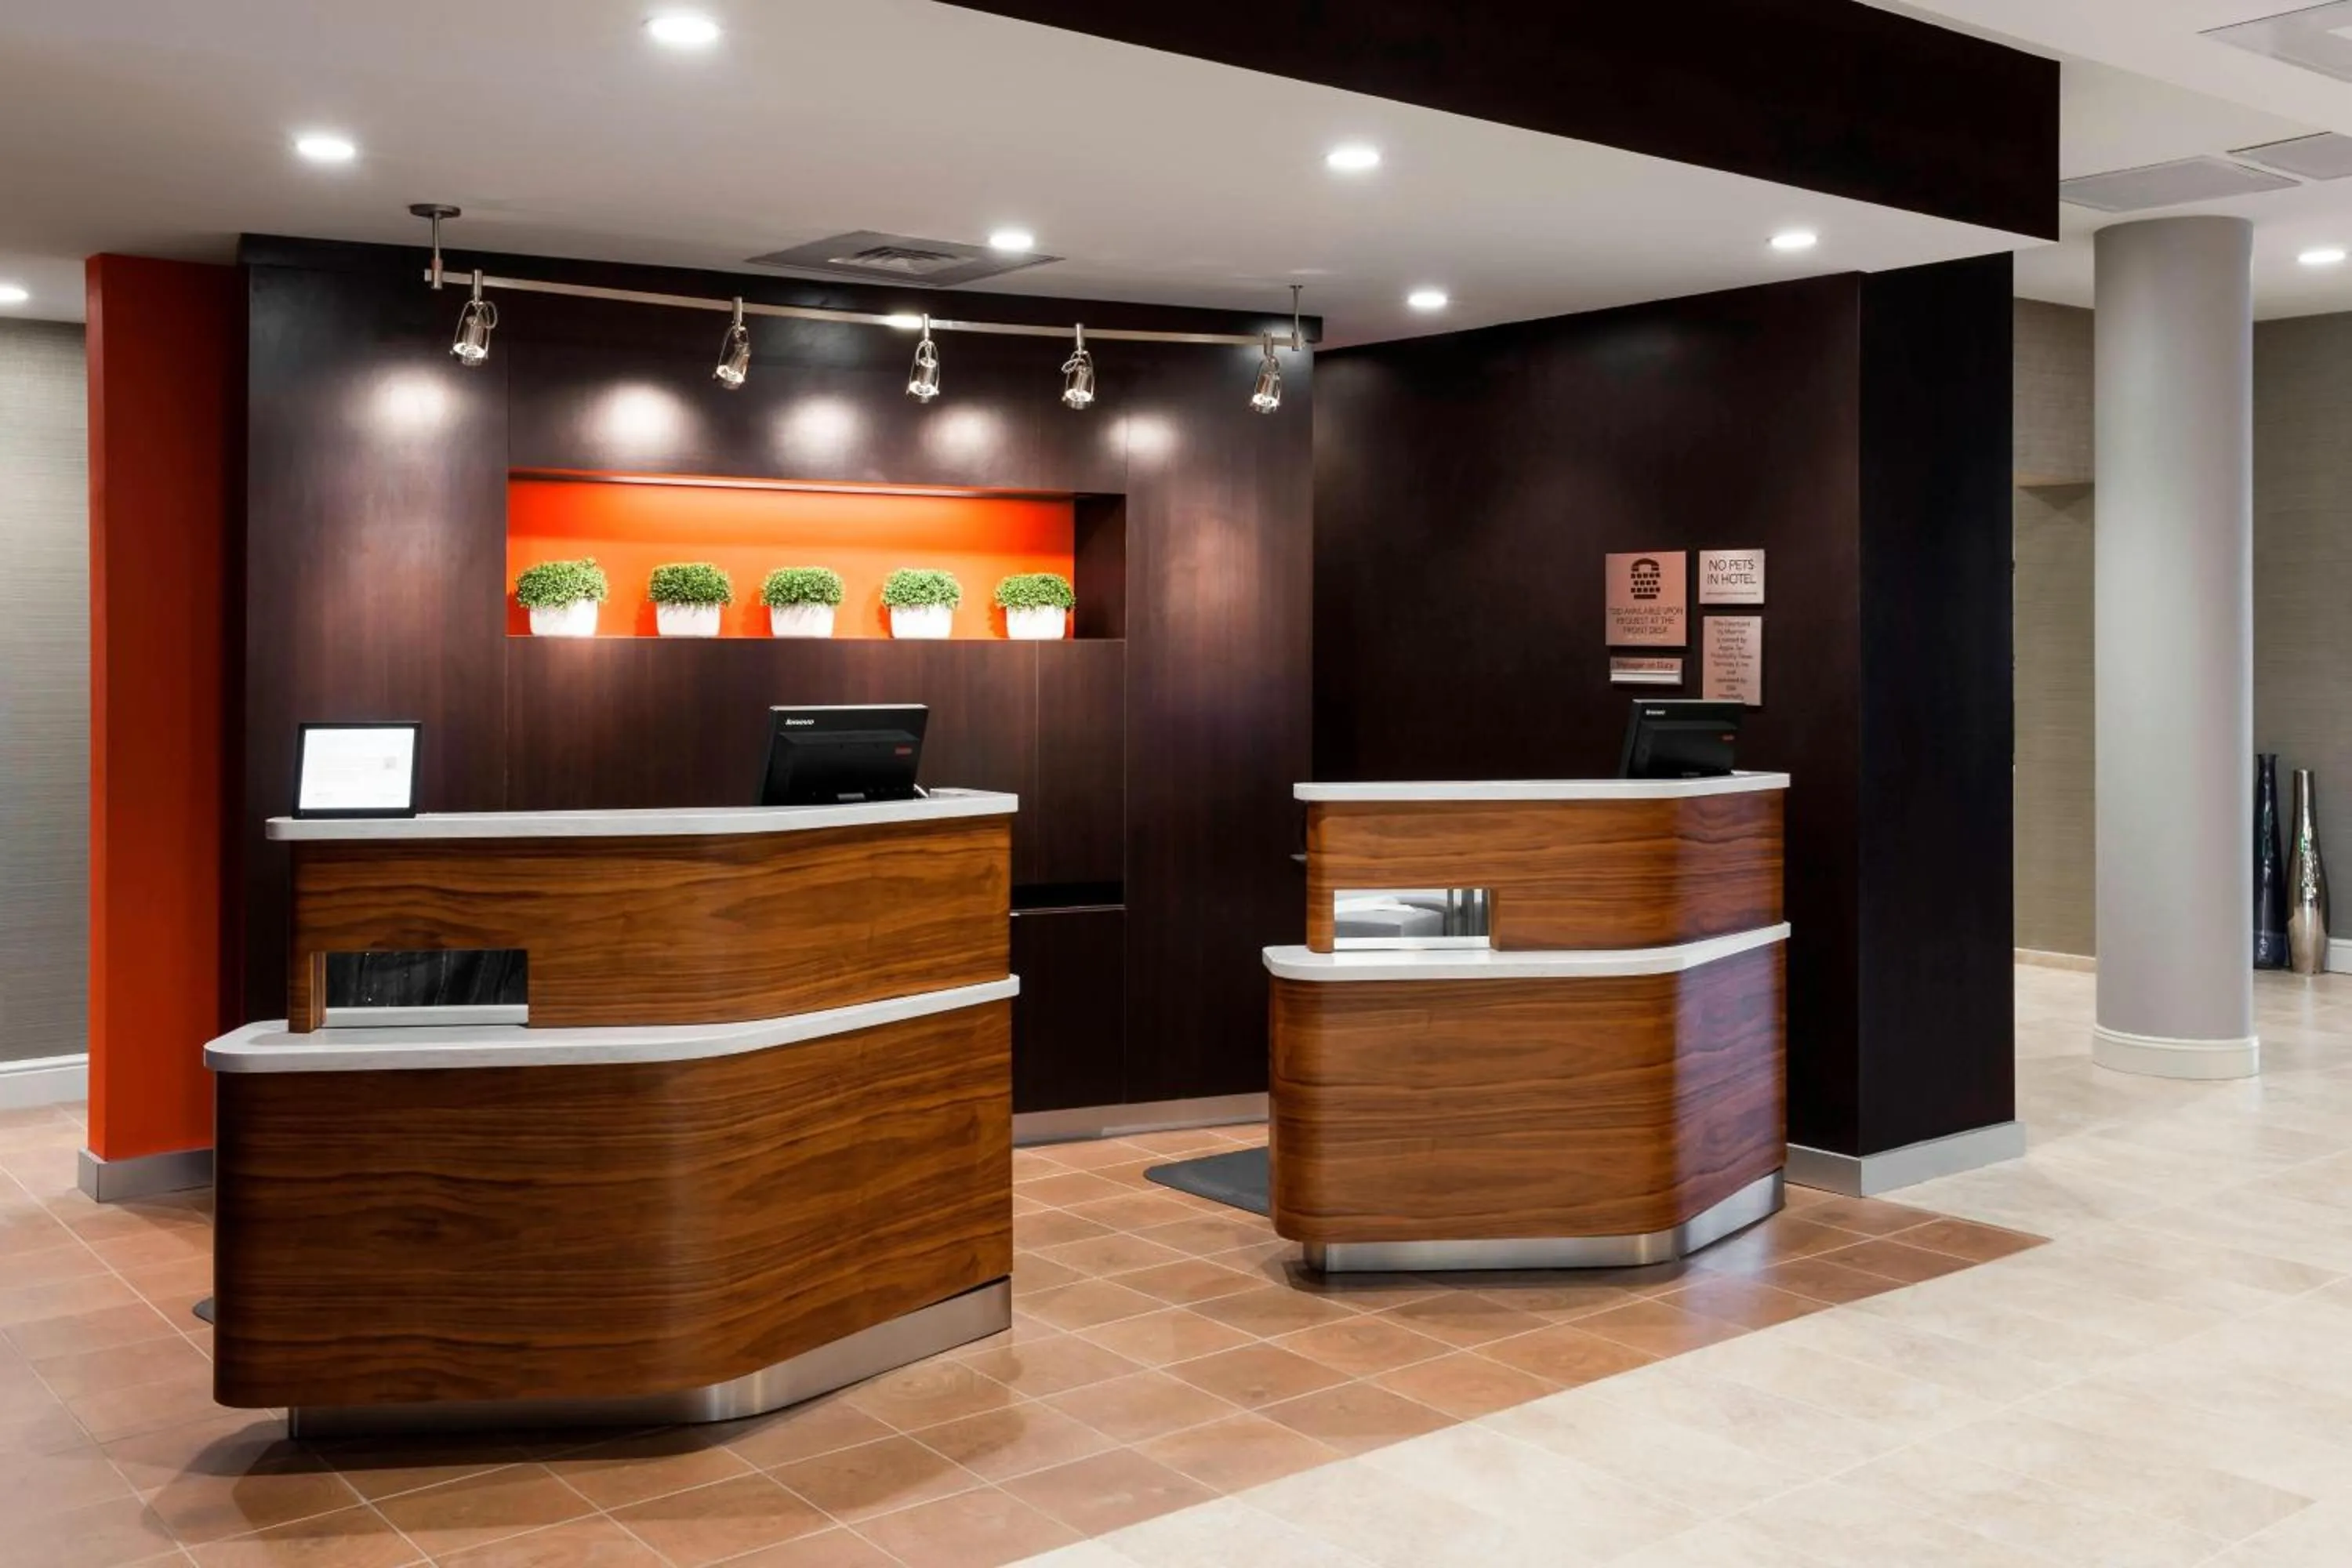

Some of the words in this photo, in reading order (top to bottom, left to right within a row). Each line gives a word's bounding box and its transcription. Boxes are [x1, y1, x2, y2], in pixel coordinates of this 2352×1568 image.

[1708, 559, 1727, 571] NO
[1729, 559, 1755, 571] PETS
[1707, 573, 1719, 584] IN
[1721, 573, 1756, 584] HOTEL
[1624, 607, 1661, 615] AVAILABLE
[1661, 606, 1683, 615] UPON
[1616, 616, 1648, 625] REQUEST
[1650, 616, 1660, 625] AT
[1661, 616, 1675, 625] THE
[1623, 626, 1648, 634] FRONT
[1649, 626, 1668, 634] DESK
[1657, 661, 1675, 671] Duty
